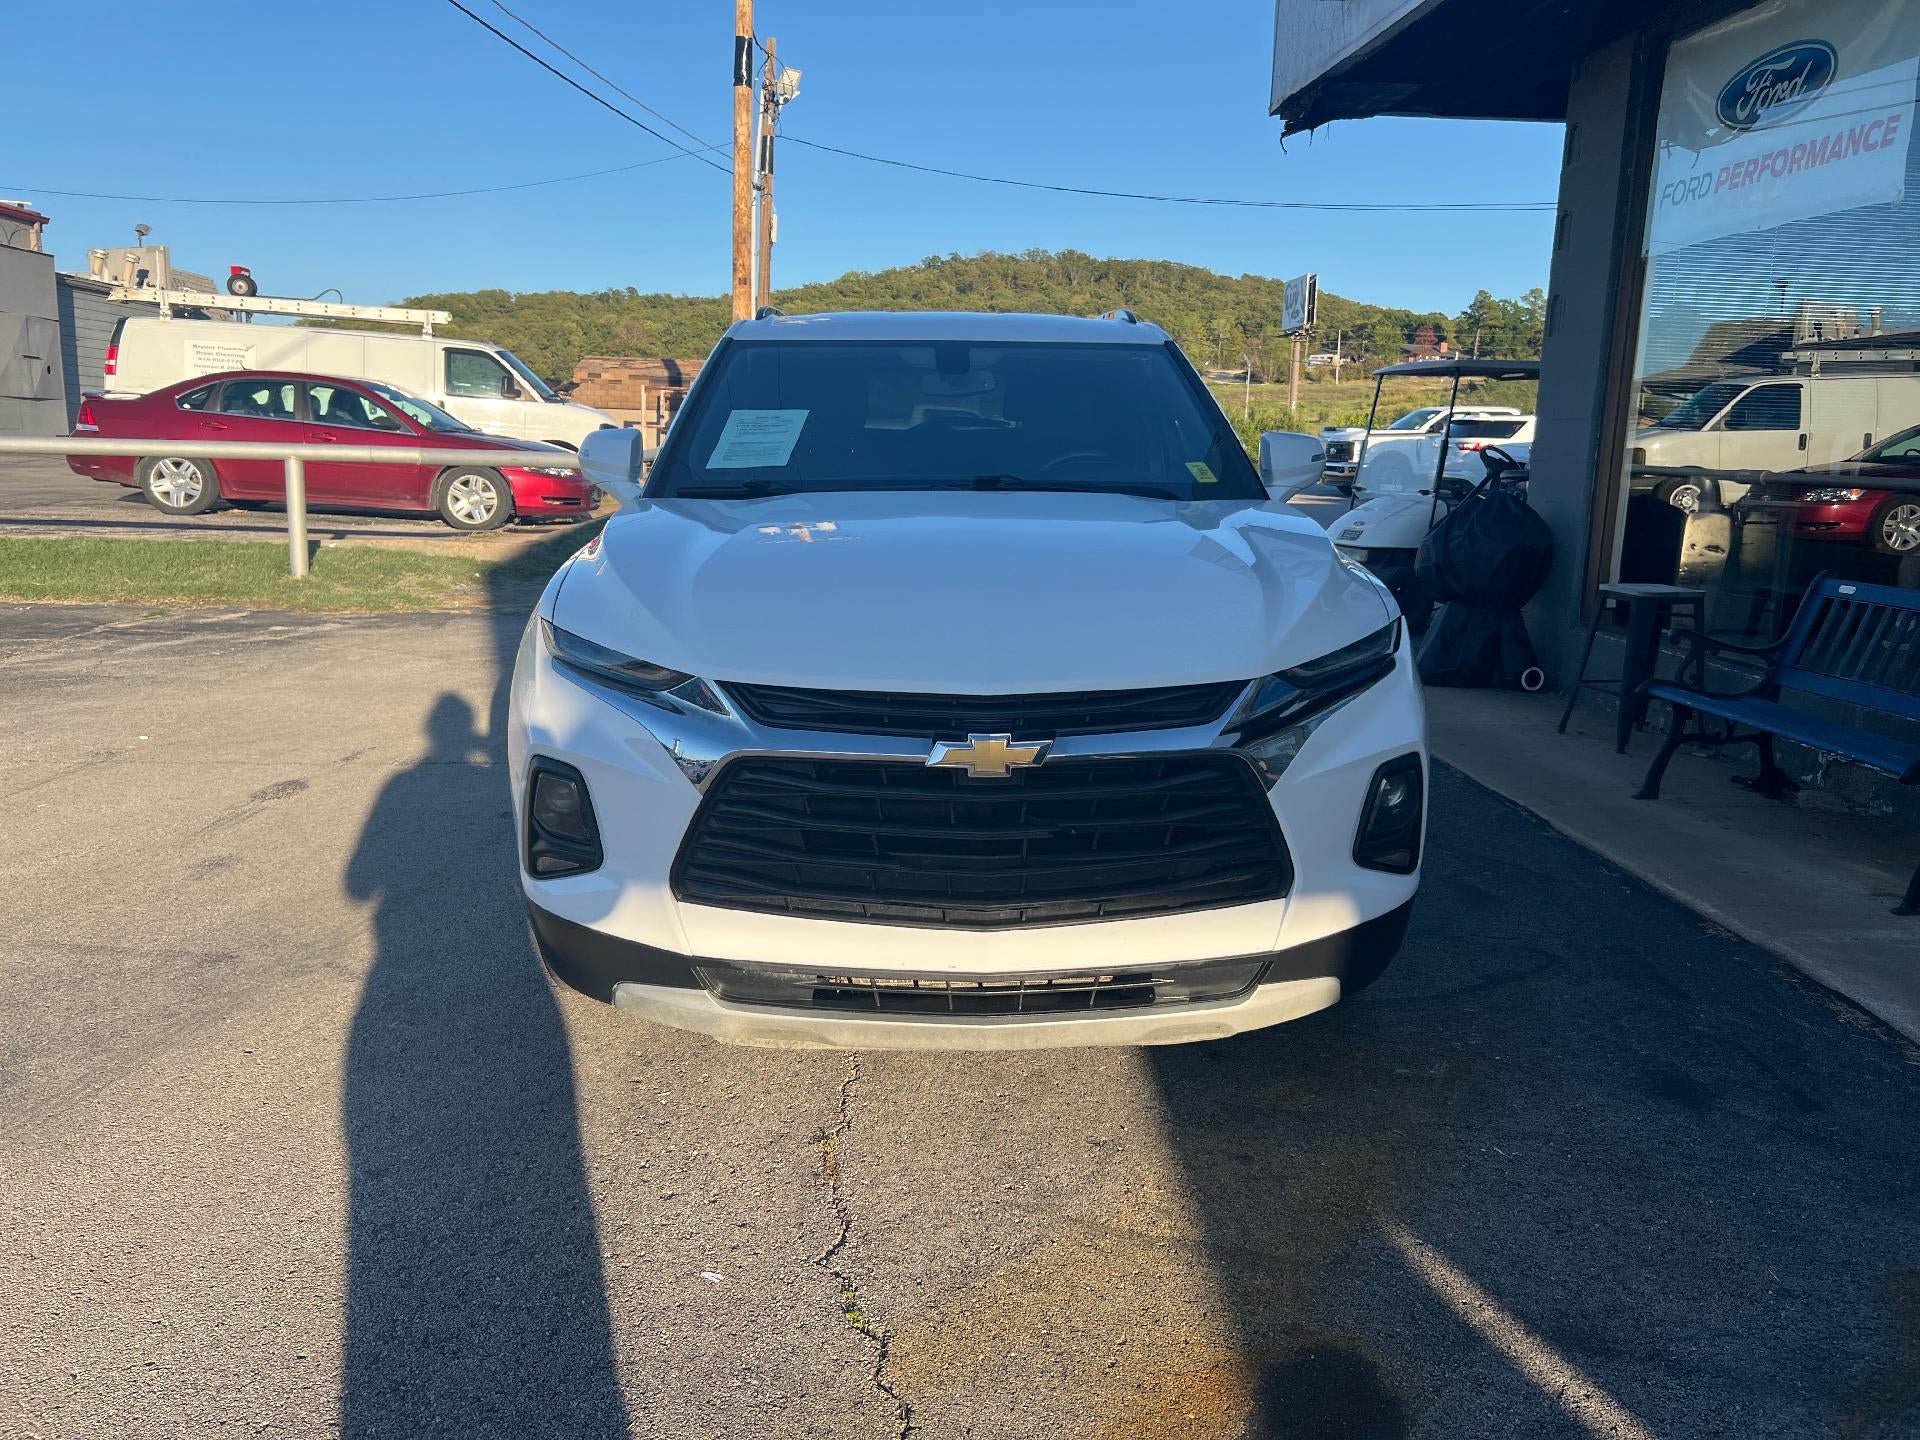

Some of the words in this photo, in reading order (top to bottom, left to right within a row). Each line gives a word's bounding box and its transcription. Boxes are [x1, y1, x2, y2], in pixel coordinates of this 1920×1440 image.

[1735, 56, 1813, 121] Ford
[1659, 172, 1713, 209] FORD
[1713, 114, 1902, 194] PERFORMANCE
